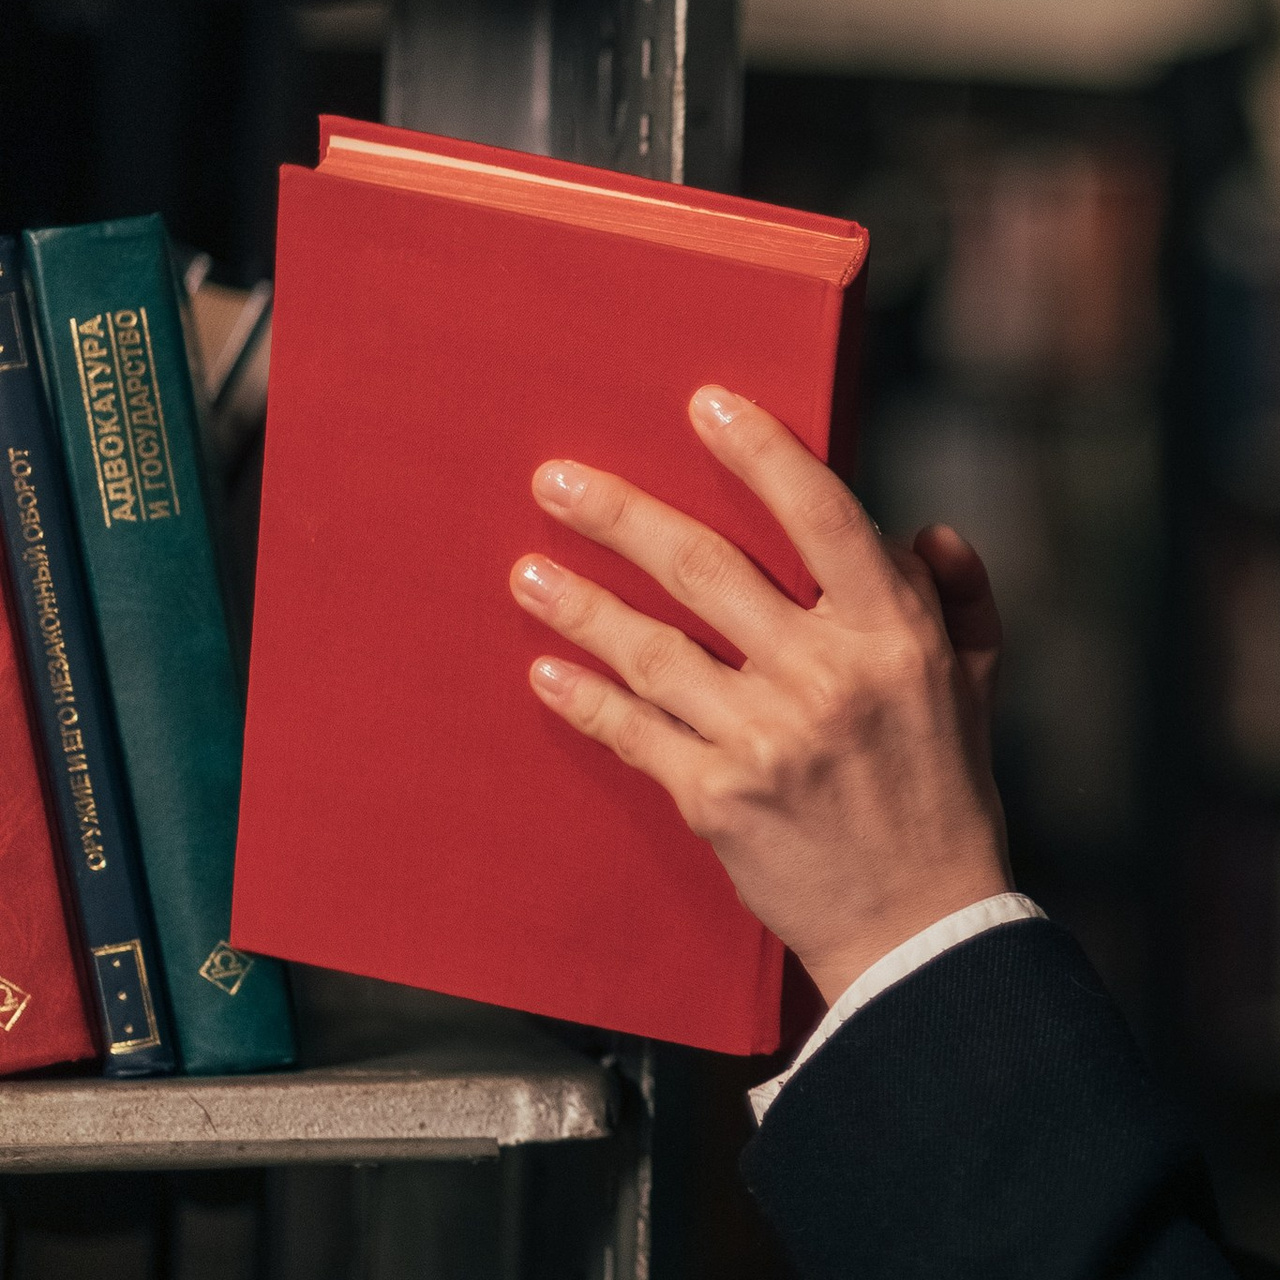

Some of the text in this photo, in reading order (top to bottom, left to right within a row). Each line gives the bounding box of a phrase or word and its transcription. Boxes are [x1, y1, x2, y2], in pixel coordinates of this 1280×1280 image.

[78, 314, 137, 522] АДВОКАТУРА
[114, 310, 171, 520] И ГОСУДАРСТВО
[8, 448, 107, 872] ОРУЖИЕ И ЕГО НЕЗАКОННЫЙ ОБОРОТ
